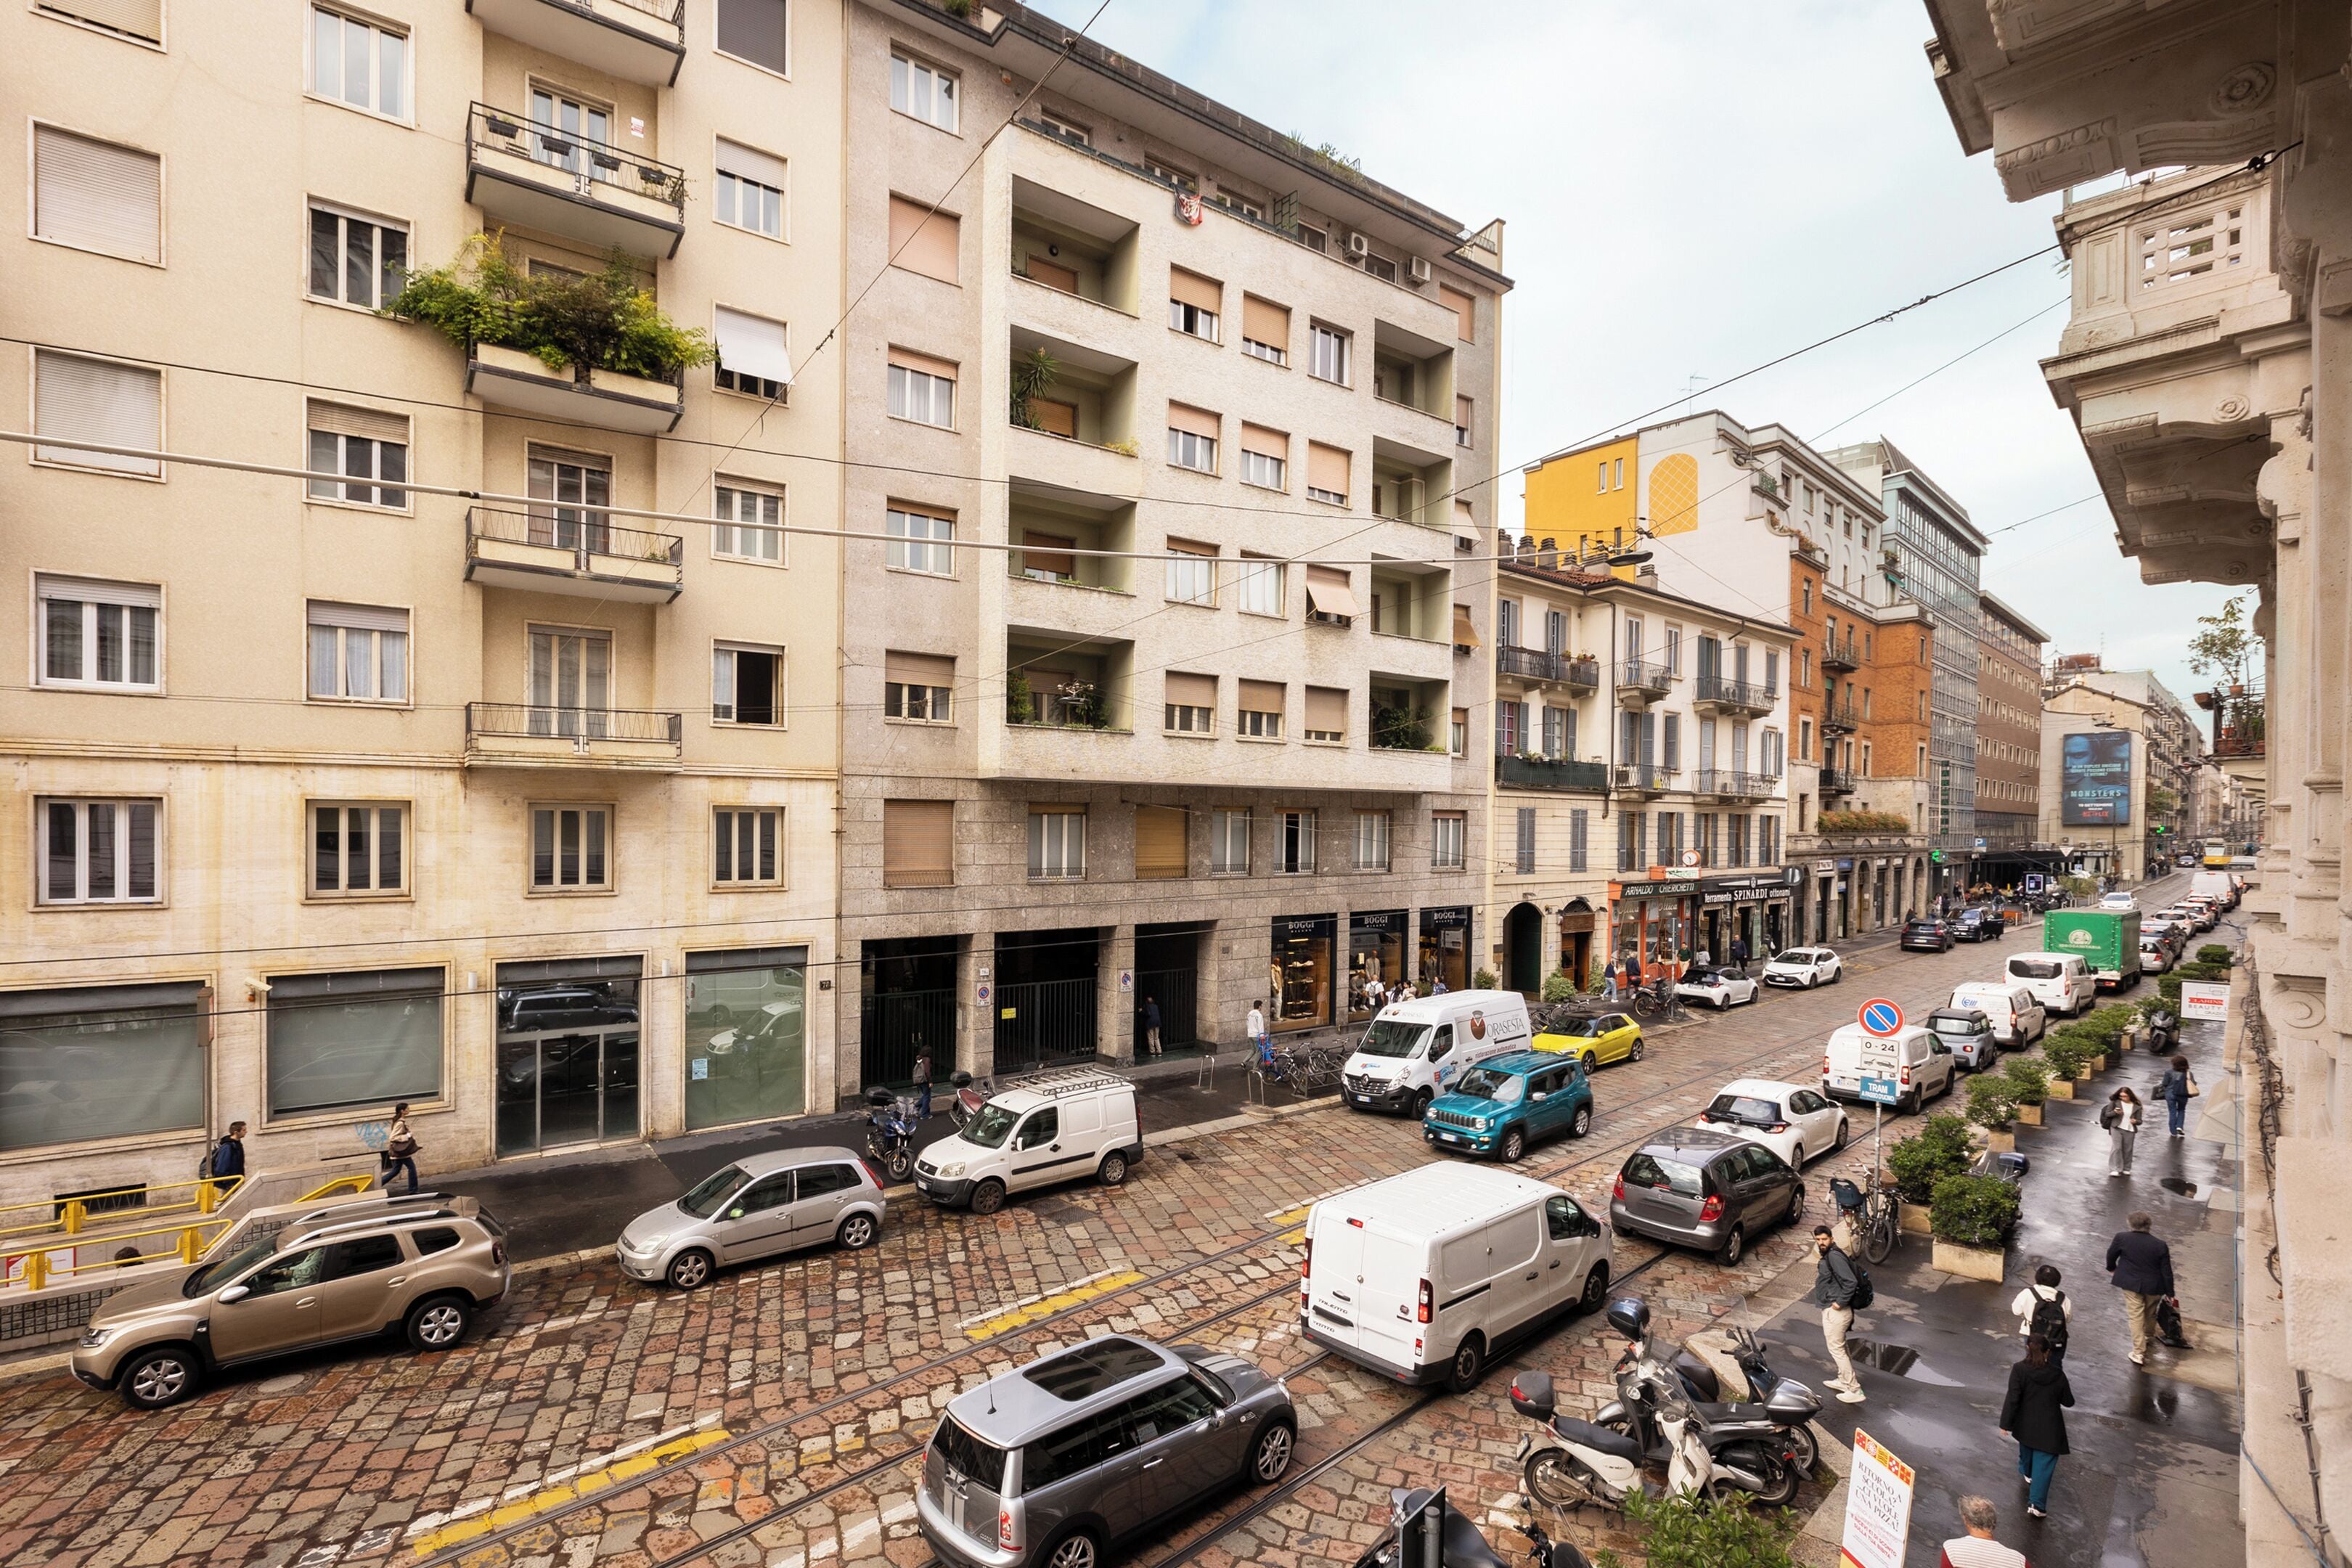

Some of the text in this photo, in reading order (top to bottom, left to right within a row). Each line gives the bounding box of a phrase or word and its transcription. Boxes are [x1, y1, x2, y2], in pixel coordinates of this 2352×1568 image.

[1975, 838, 1983, 846] P
[1625, 883, 1694, 896] ARNALDO CHIERICHETTI
[1704, 887, 1790, 903] ferramenta SPINARDI ottonami
[1289, 921, 1315, 930] BOGGI
[1487, 1018, 1525, 1037] ORASESTA
[1868, 1082, 1888, 1094] TRAM
[1318, 1298, 1348, 1314] TALENTO
[1858, 1461, 1902, 1503] RITORNO A
[1862, 1474, 1897, 1508] SCUOLA?
[1855, 1489, 1871, 1509] UNA
[1874, 1506, 1899, 1532] PIZZA!
[1872, 1492, 1899, 1522] VUOLE
